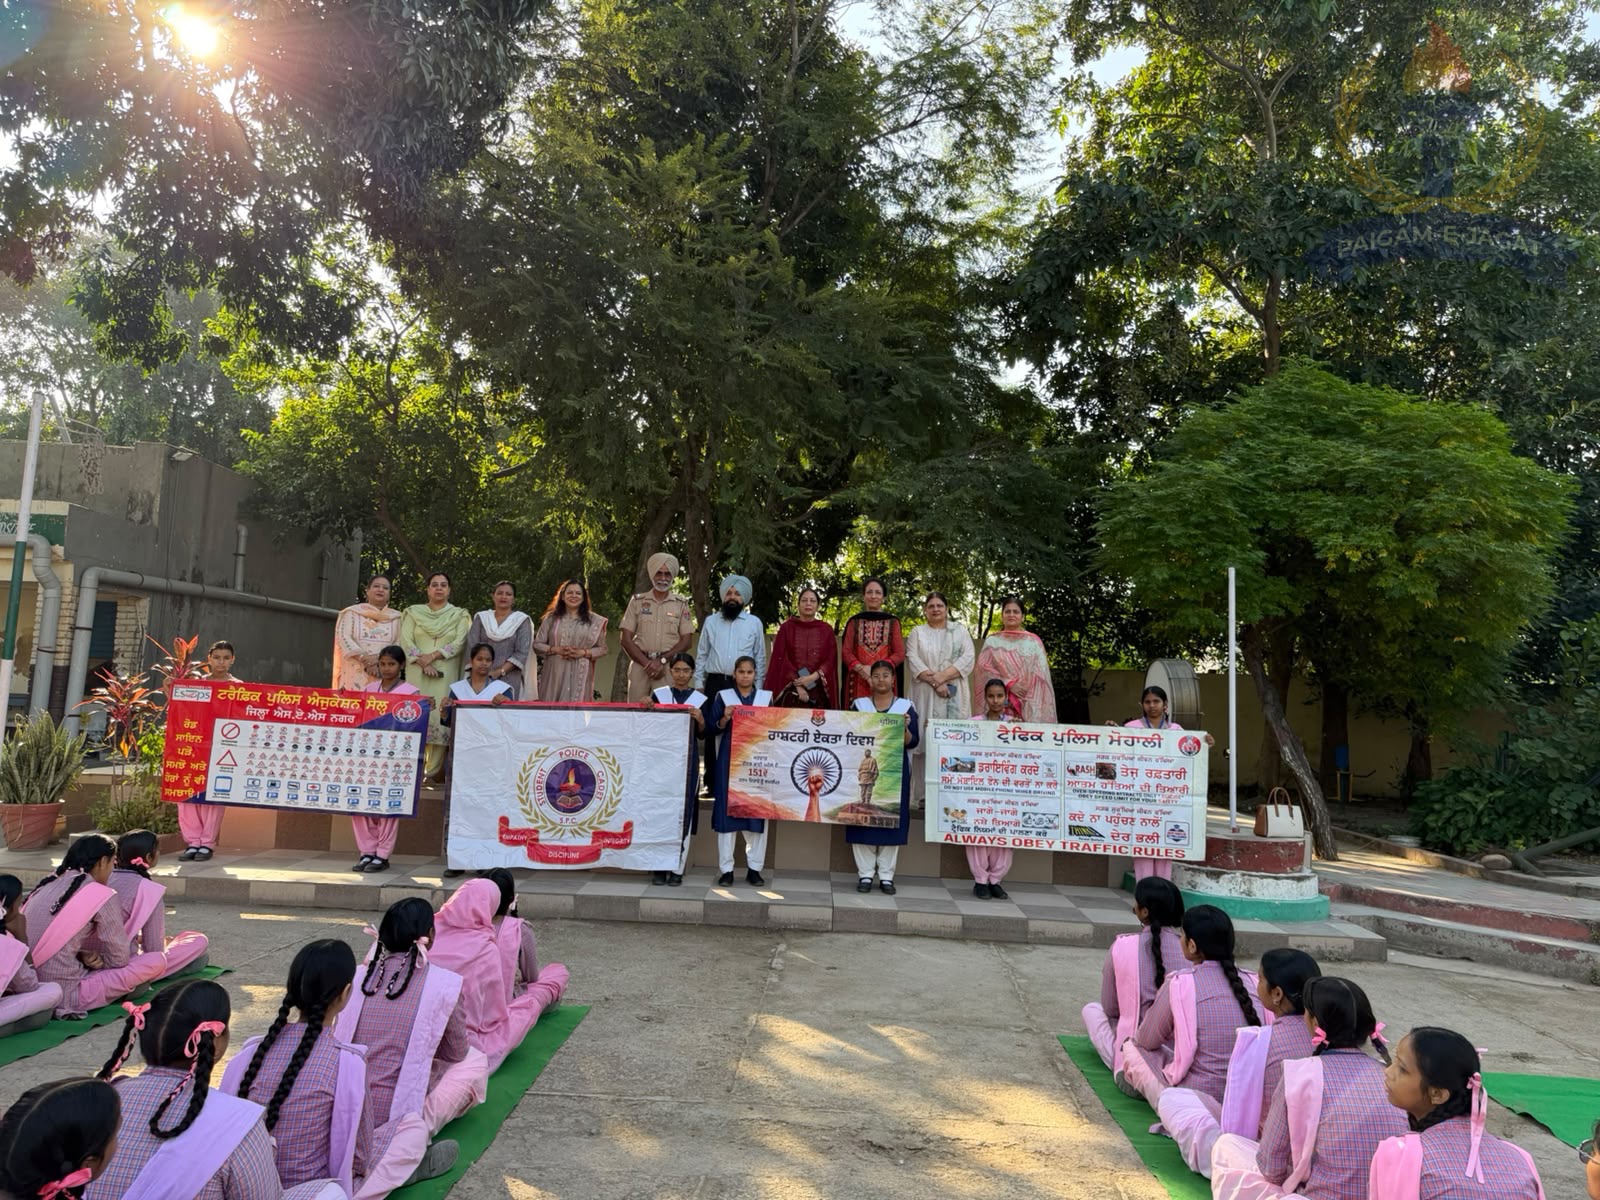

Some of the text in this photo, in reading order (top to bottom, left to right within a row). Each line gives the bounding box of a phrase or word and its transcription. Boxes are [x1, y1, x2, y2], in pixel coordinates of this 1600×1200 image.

[267, 690, 303, 706] ਪੁਲਿਸ
[330, 713, 356, 724] ਨਗਰ
[176, 732, 203, 743] ਸਾਇਨ
[768, 729, 876, 747] ਰਾਸ਼ਟਰੀ ਏਕਤਾ ਦਿਵਸ
[997, 724, 1164, 749] ਟ੍ਰੈਫਿਕ ਪੁਲਿਸ ਮੋਹਾਲੀ
[559, 748, 590, 761] POLICE
[190, 761, 207, 771] ਅਤੇ
[1020, 762, 1040, 776] ਕਰਦੇ
[1120, 764, 1140, 781] ਤੇਜ਼
[183, 773, 193, 787] ਨੂੰ
[194, 775, 206, 785] ਵੀ
[536, 767, 547, 807] STUDENT
[596, 770, 606, 802] CADET
[1002, 777, 1011, 787] ਦੀ
[1034, 780, 1044, 789] ਨਾ
[1067, 780, 1097, 789] ਆਤਮ
[1140, 782, 1151, 792] ਦੀ
[1156, 783, 1190, 795] ਤਿਆਰੀ
[1068, 811, 1086, 822] ਕਦੇ
[1090, 813, 1102, 823] ਨਾ
[998, 826, 1007, 835] ਦੀ
[1110, 829, 1131, 842] ਦੇਰ
[1135, 831, 1161, 845] ਭਲੀ
[944, 832, 1186, 859] ALWAYS OBEY TRAFFIC RULES
[548, 850, 580, 860] DISCIPLINE
